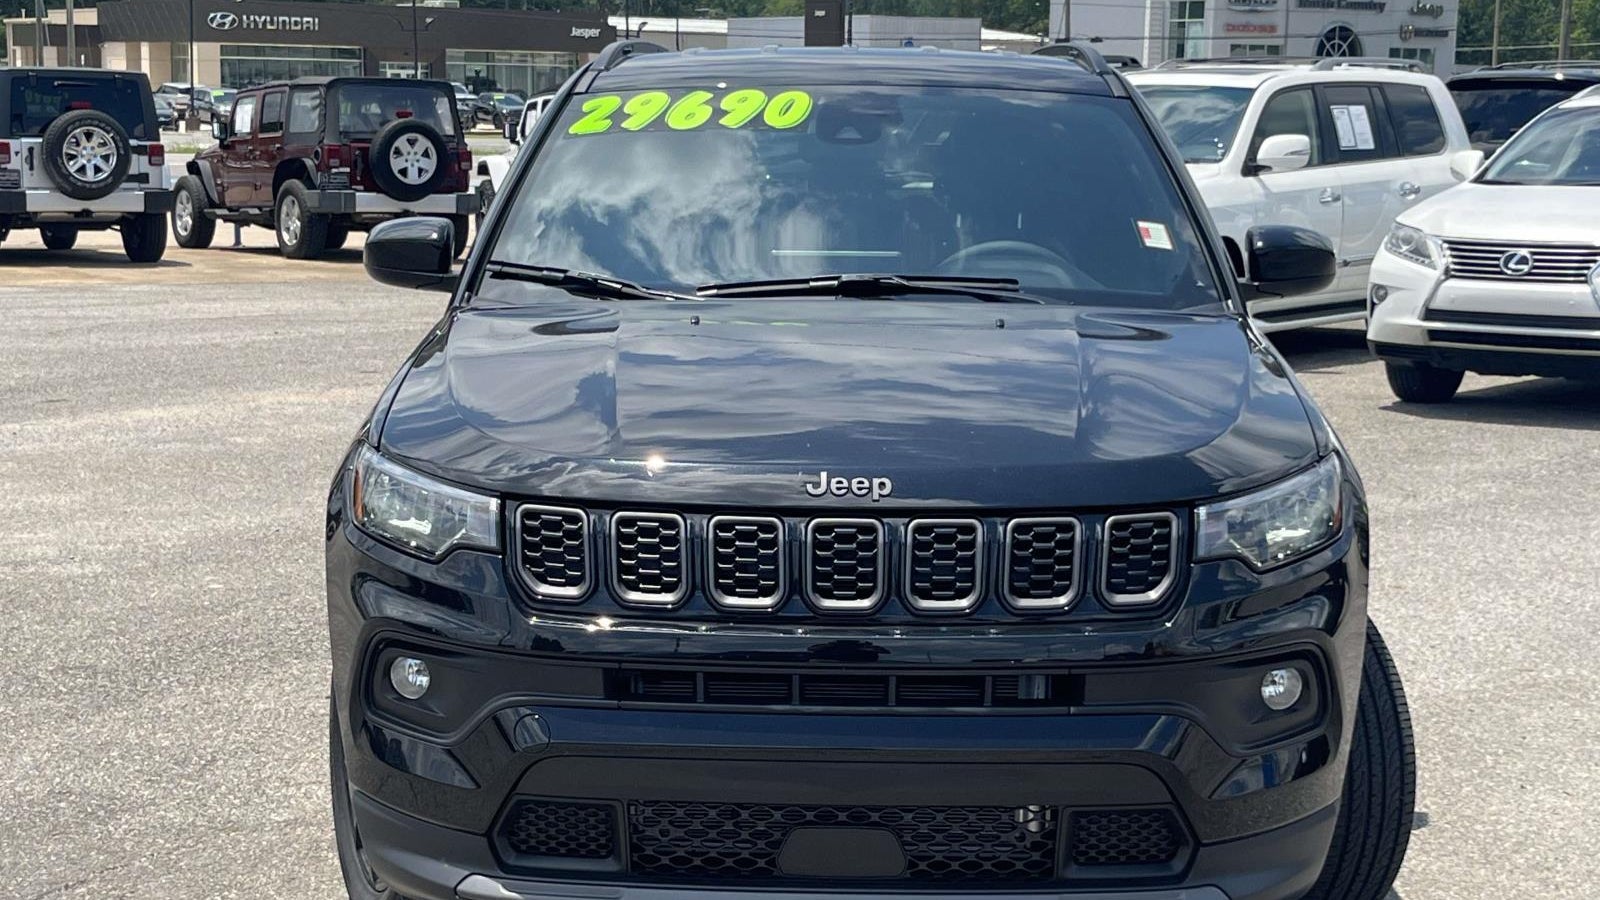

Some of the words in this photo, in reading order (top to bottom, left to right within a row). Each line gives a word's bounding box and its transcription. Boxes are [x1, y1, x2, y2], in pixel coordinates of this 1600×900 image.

[242, 14, 320, 31] HYUNDAI
[570, 26, 601, 39] Jasper
[567, 89, 813, 135] 29690
[806, 471, 893, 502] Jeep
